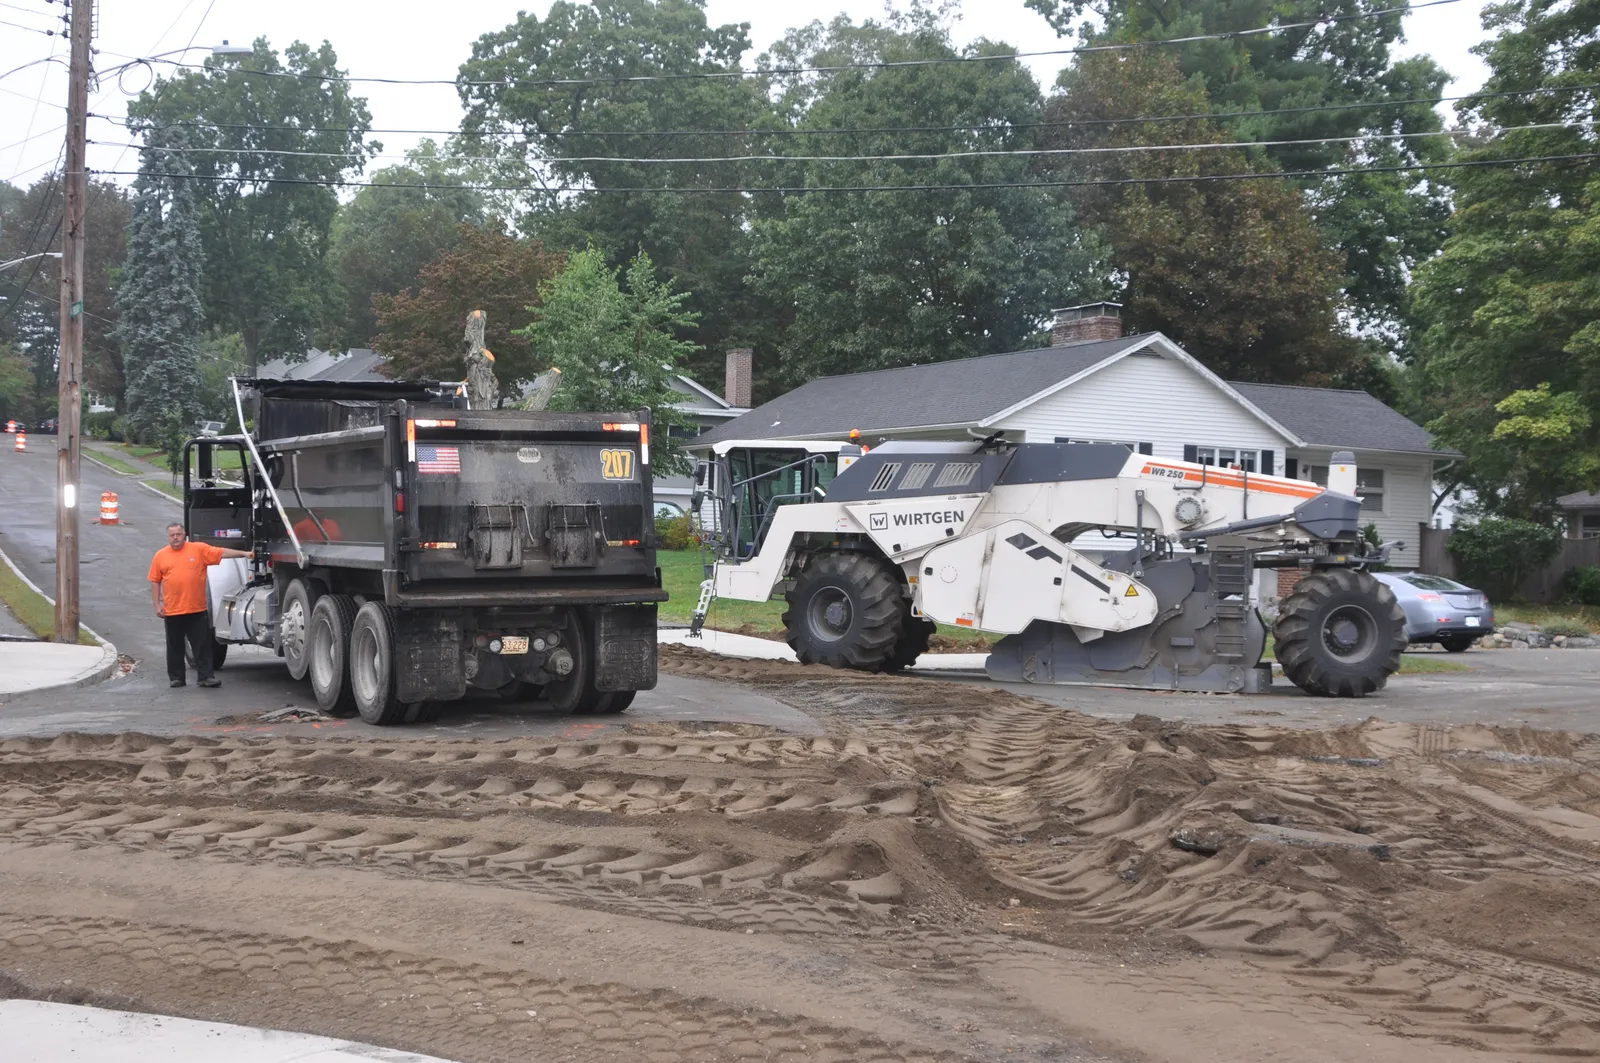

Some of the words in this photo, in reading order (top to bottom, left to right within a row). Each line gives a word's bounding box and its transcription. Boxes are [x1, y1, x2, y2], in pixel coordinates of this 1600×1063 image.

[602, 450, 631, 478] 207
[1151, 467, 1166, 476] WR
[1167, 470, 1184, 479] 250
[893, 510, 964, 526] WIRTGEN
